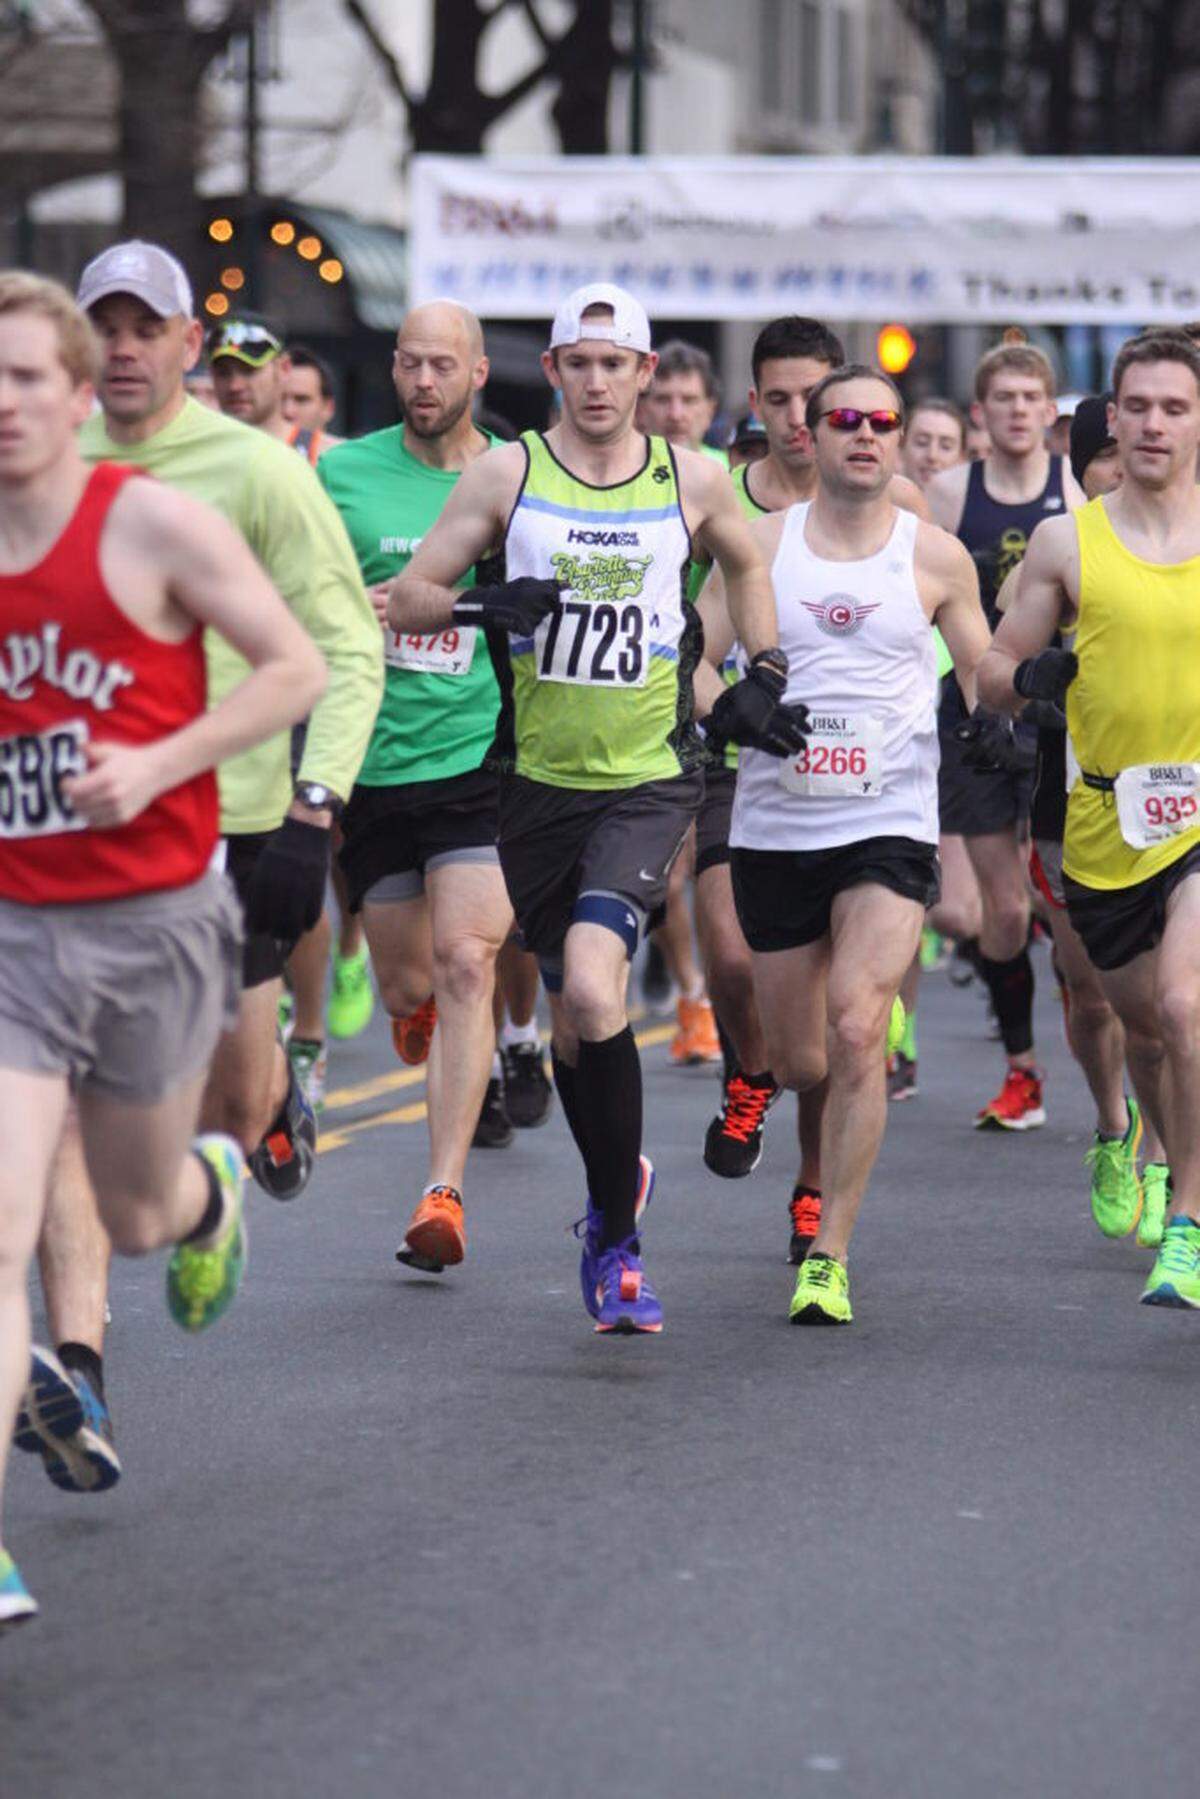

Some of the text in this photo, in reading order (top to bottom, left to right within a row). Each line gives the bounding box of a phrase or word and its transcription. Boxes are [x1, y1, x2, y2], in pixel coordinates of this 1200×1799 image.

[380, 536, 408, 553] NEW
[567, 529, 618, 546] HOKA
[794, 746, 866, 775] 3266
